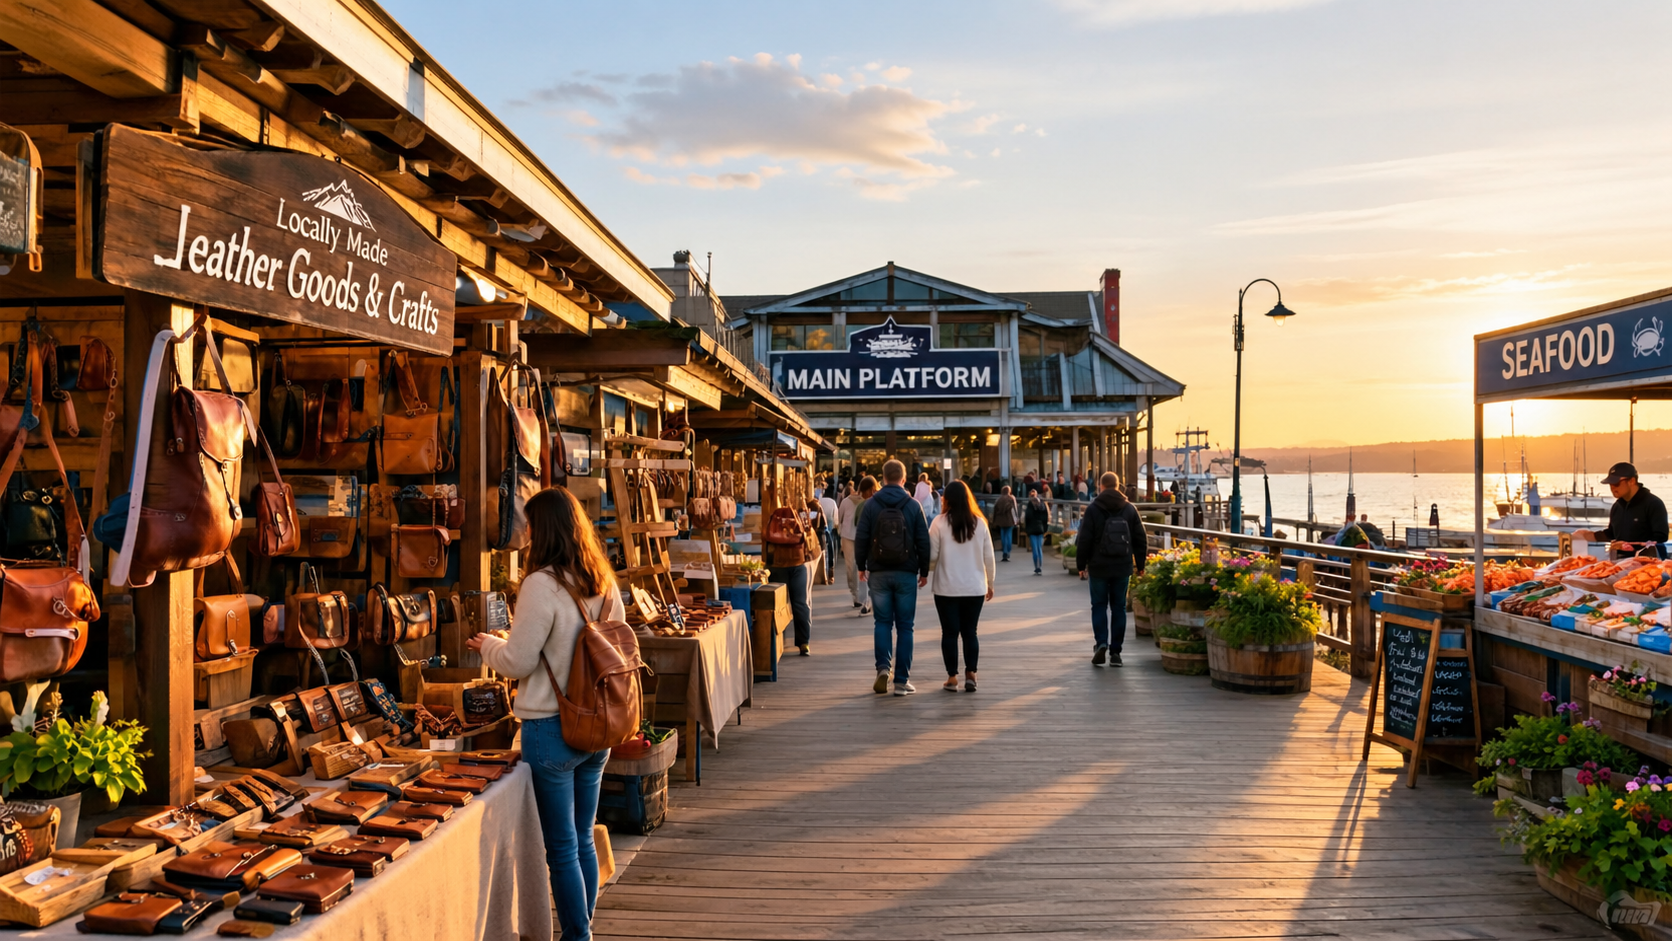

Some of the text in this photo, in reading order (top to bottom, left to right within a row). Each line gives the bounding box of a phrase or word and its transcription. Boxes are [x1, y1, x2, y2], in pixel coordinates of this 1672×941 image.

[276, 197, 388, 266] Locally Made
[287, 248, 361, 313] Goods
[364, 272, 384, 318] &
[388, 281, 440, 335] Crafts
[787, 366, 991, 390] MAIN PLATFORM
[1501, 322, 1615, 380] SEAFOOD
